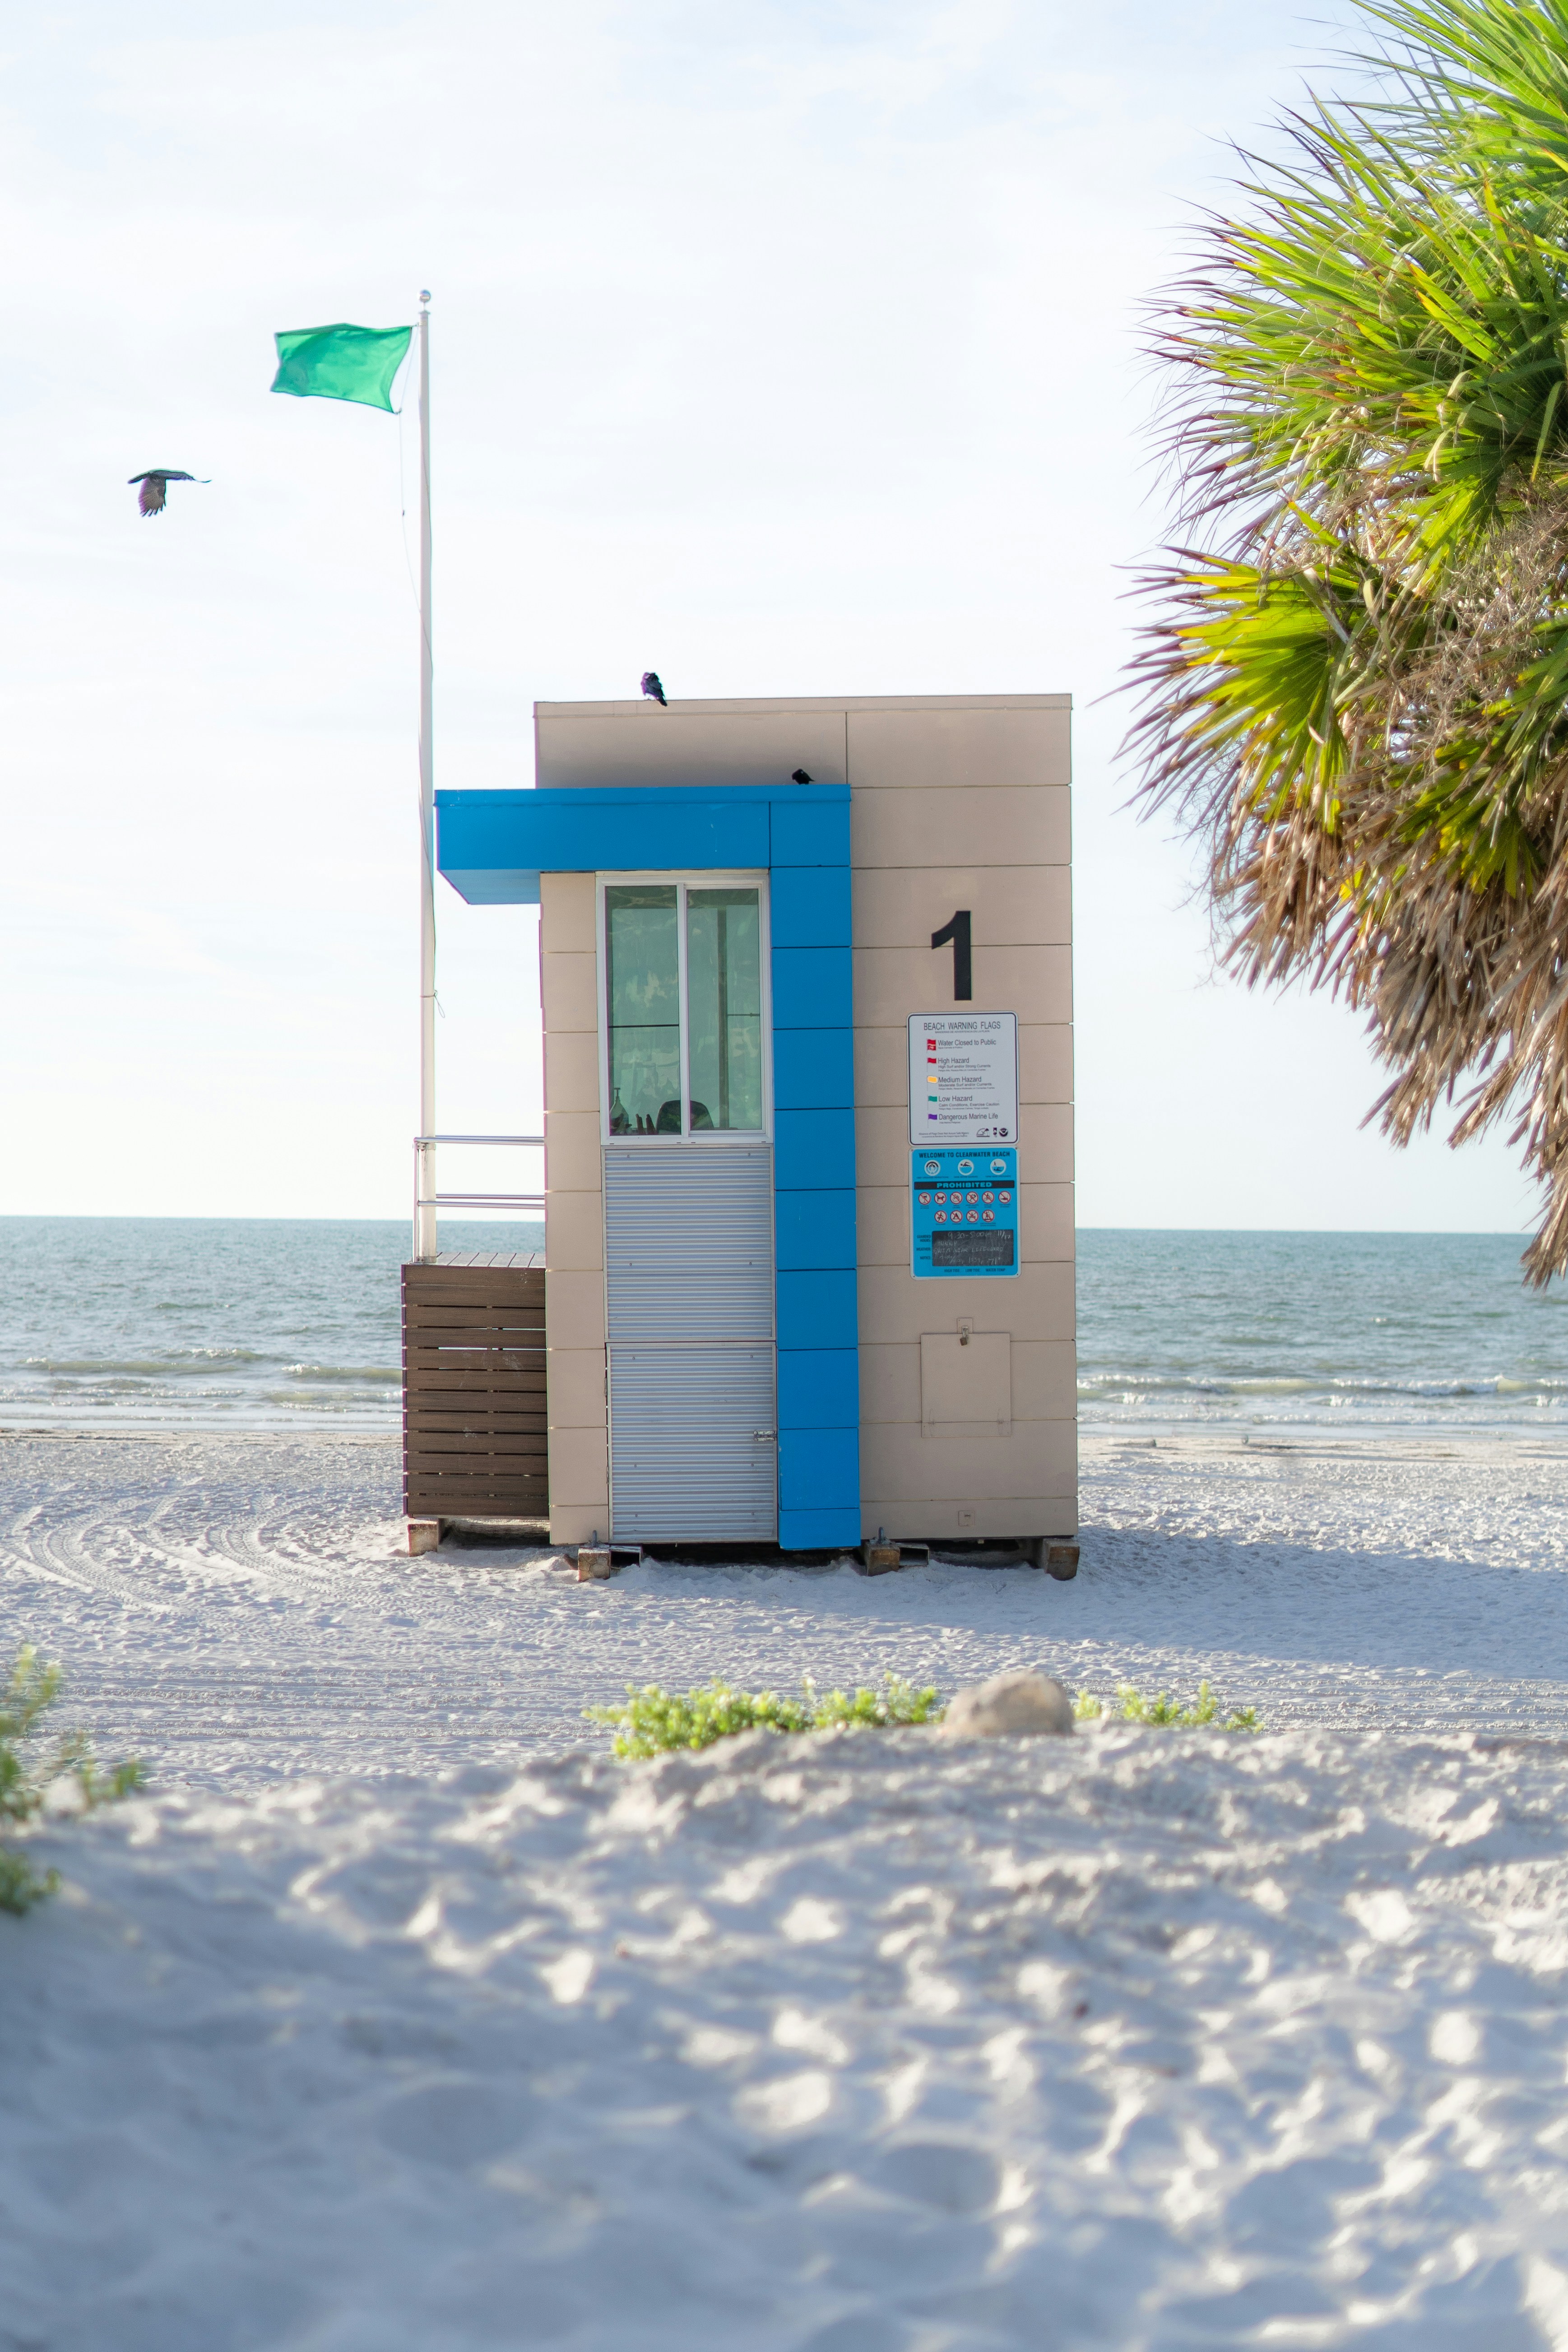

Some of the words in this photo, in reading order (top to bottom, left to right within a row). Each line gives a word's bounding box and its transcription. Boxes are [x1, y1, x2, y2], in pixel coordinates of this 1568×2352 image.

[931, 910, 972, 1001] 1
[923, 1022, 945, 1030] BEACH
[948, 1021, 977, 1030] WARNING
